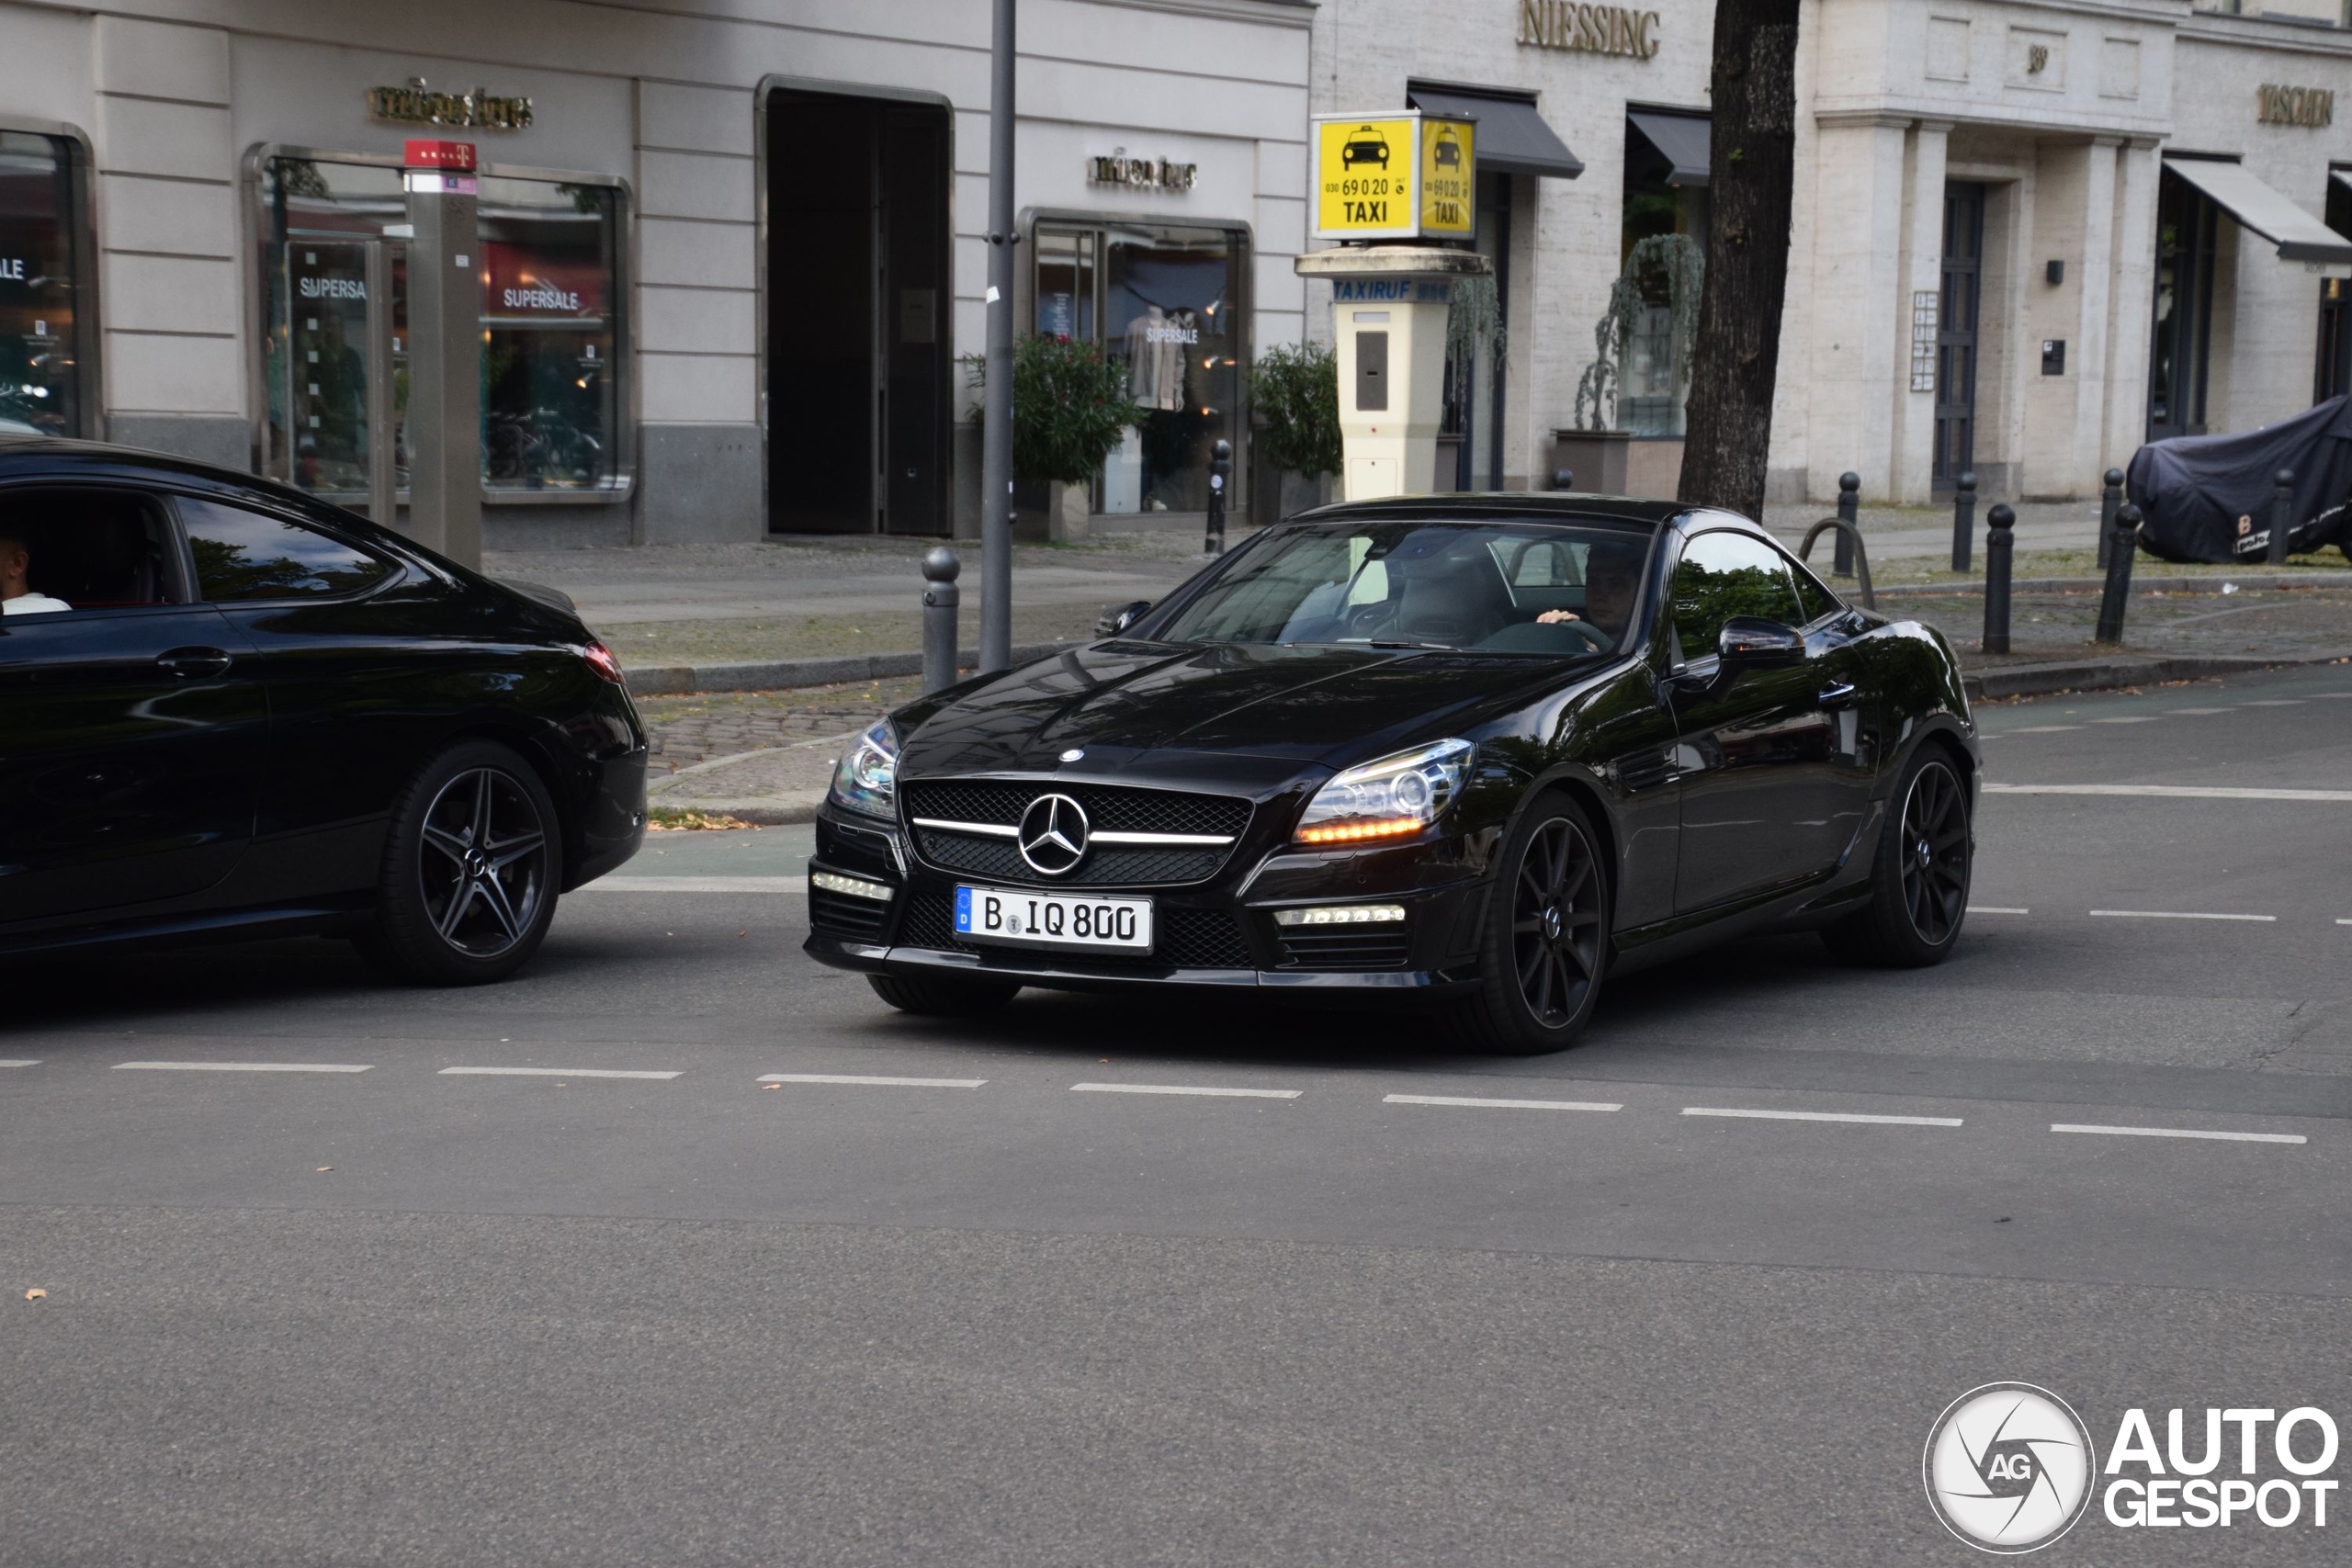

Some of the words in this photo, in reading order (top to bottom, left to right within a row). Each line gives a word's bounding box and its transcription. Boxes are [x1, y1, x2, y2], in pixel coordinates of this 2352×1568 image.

[1516, 0, 1661, 60] NIESSING
[1325, 183, 1340, 192] 030
[1343, 200, 1387, 222] TAXI
[1434, 201, 1459, 224] TAXI
[0, 258, 24, 280] LE
[503, 288, 578, 310] SUPERSALE
[1332, 280, 1411, 299] TAXIRUF
[1147, 328, 1198, 344] SUPERSALE
[985, 897, 1002, 930] B
[1025, 900, 1065, 936] IQ
[1073, 904, 1136, 941] 800
